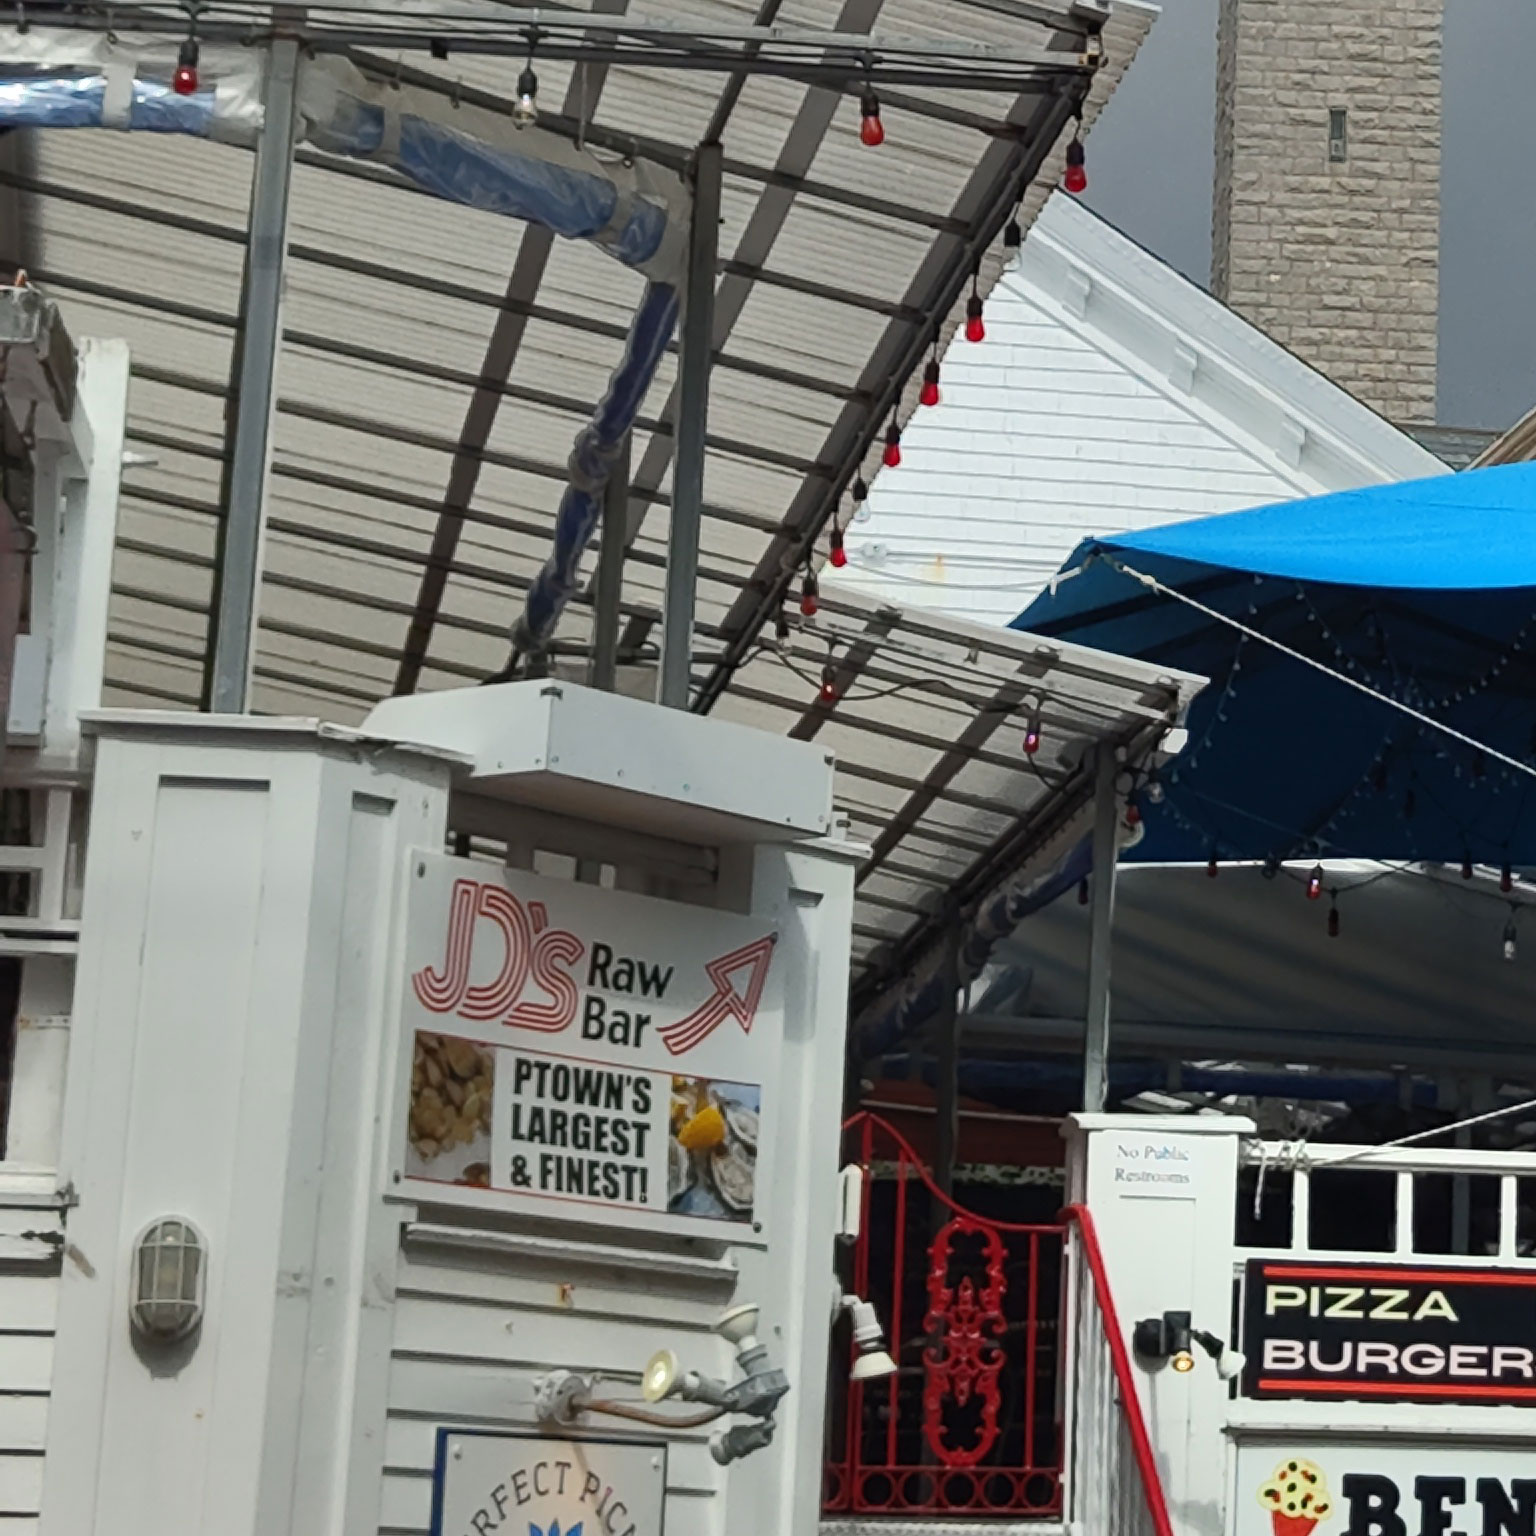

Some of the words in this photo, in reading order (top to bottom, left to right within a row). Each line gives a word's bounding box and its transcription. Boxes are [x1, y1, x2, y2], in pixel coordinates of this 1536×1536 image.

[587, 942, 674, 998] Raw
[581, 995, 652, 1049] Bar
[513, 1058, 653, 1115] PTOWN'S
[511, 1103, 651, 1158] LARGEST
[1116, 1145, 1139, 1159] No
[1144, 1146, 1189, 1161] Public
[510, 1155, 532, 1187] &
[540, 1154, 649, 1203] FINEST!
[1114, 1168, 1190, 1184] Restrooms
[1265, 1285, 1459, 1321] PIZZA
